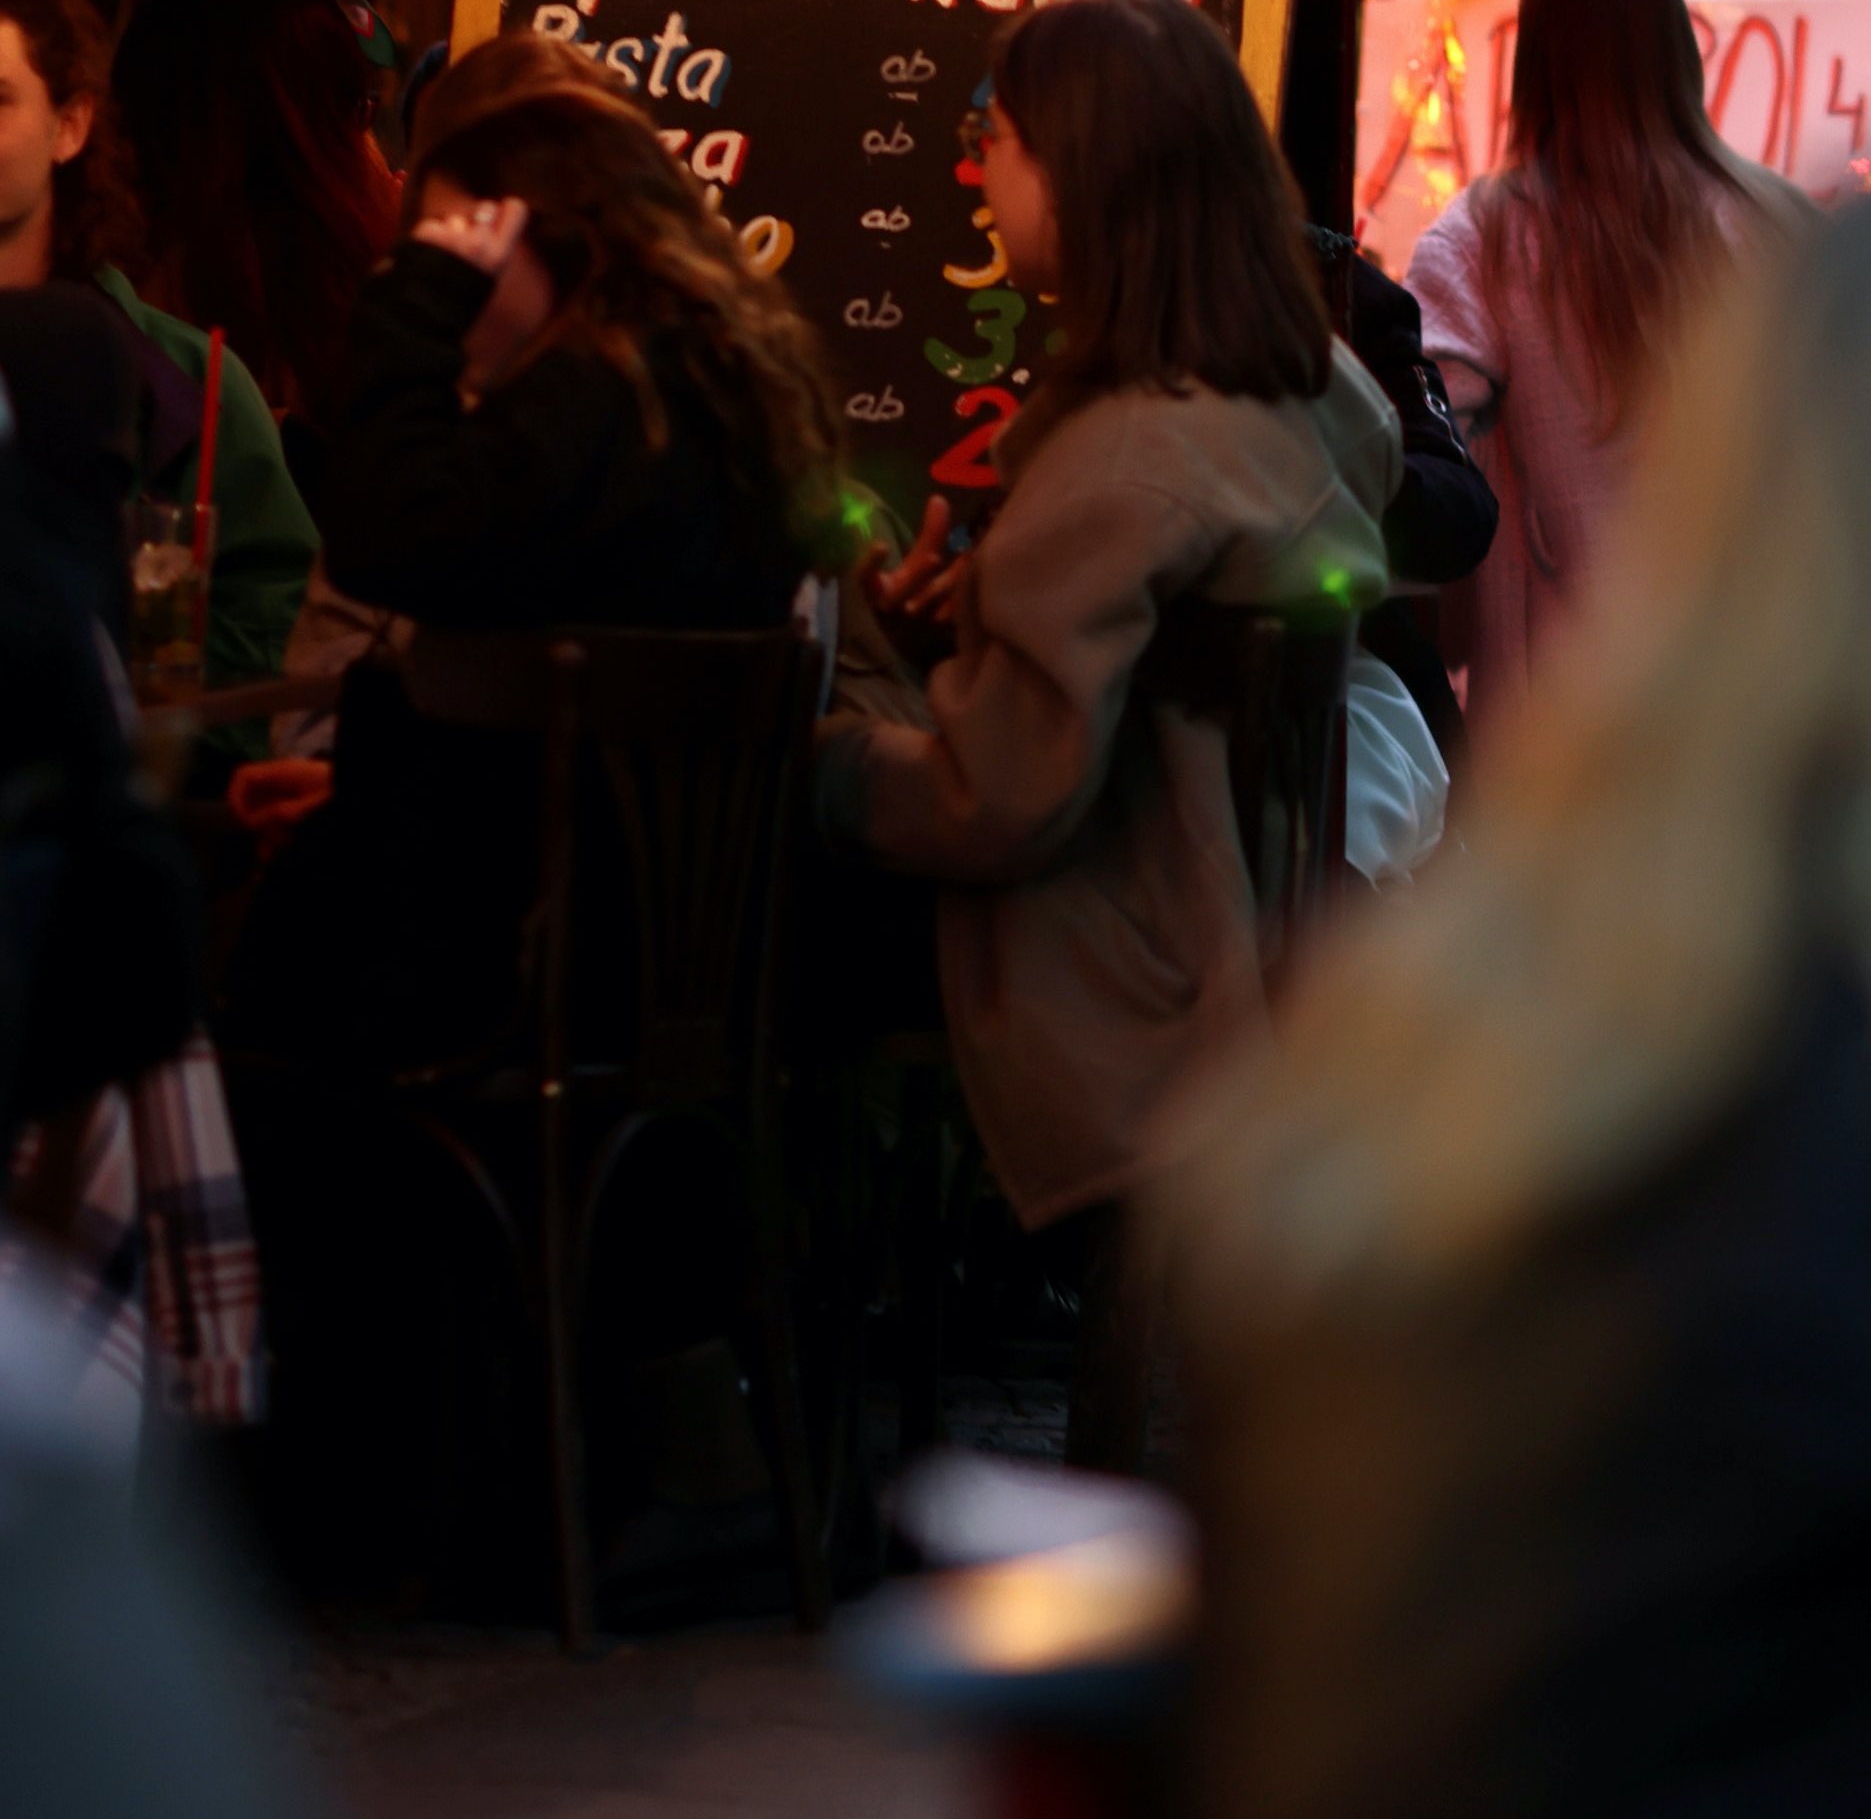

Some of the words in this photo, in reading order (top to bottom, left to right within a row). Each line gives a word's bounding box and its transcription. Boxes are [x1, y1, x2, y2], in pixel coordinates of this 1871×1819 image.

[532, 3, 732, 109] Psta
[880, 49, 937, 82] ab
[861, 121, 916, 156] ab
[843, 291, 904, 330] ab
[845, 385, 906, 422] ab
